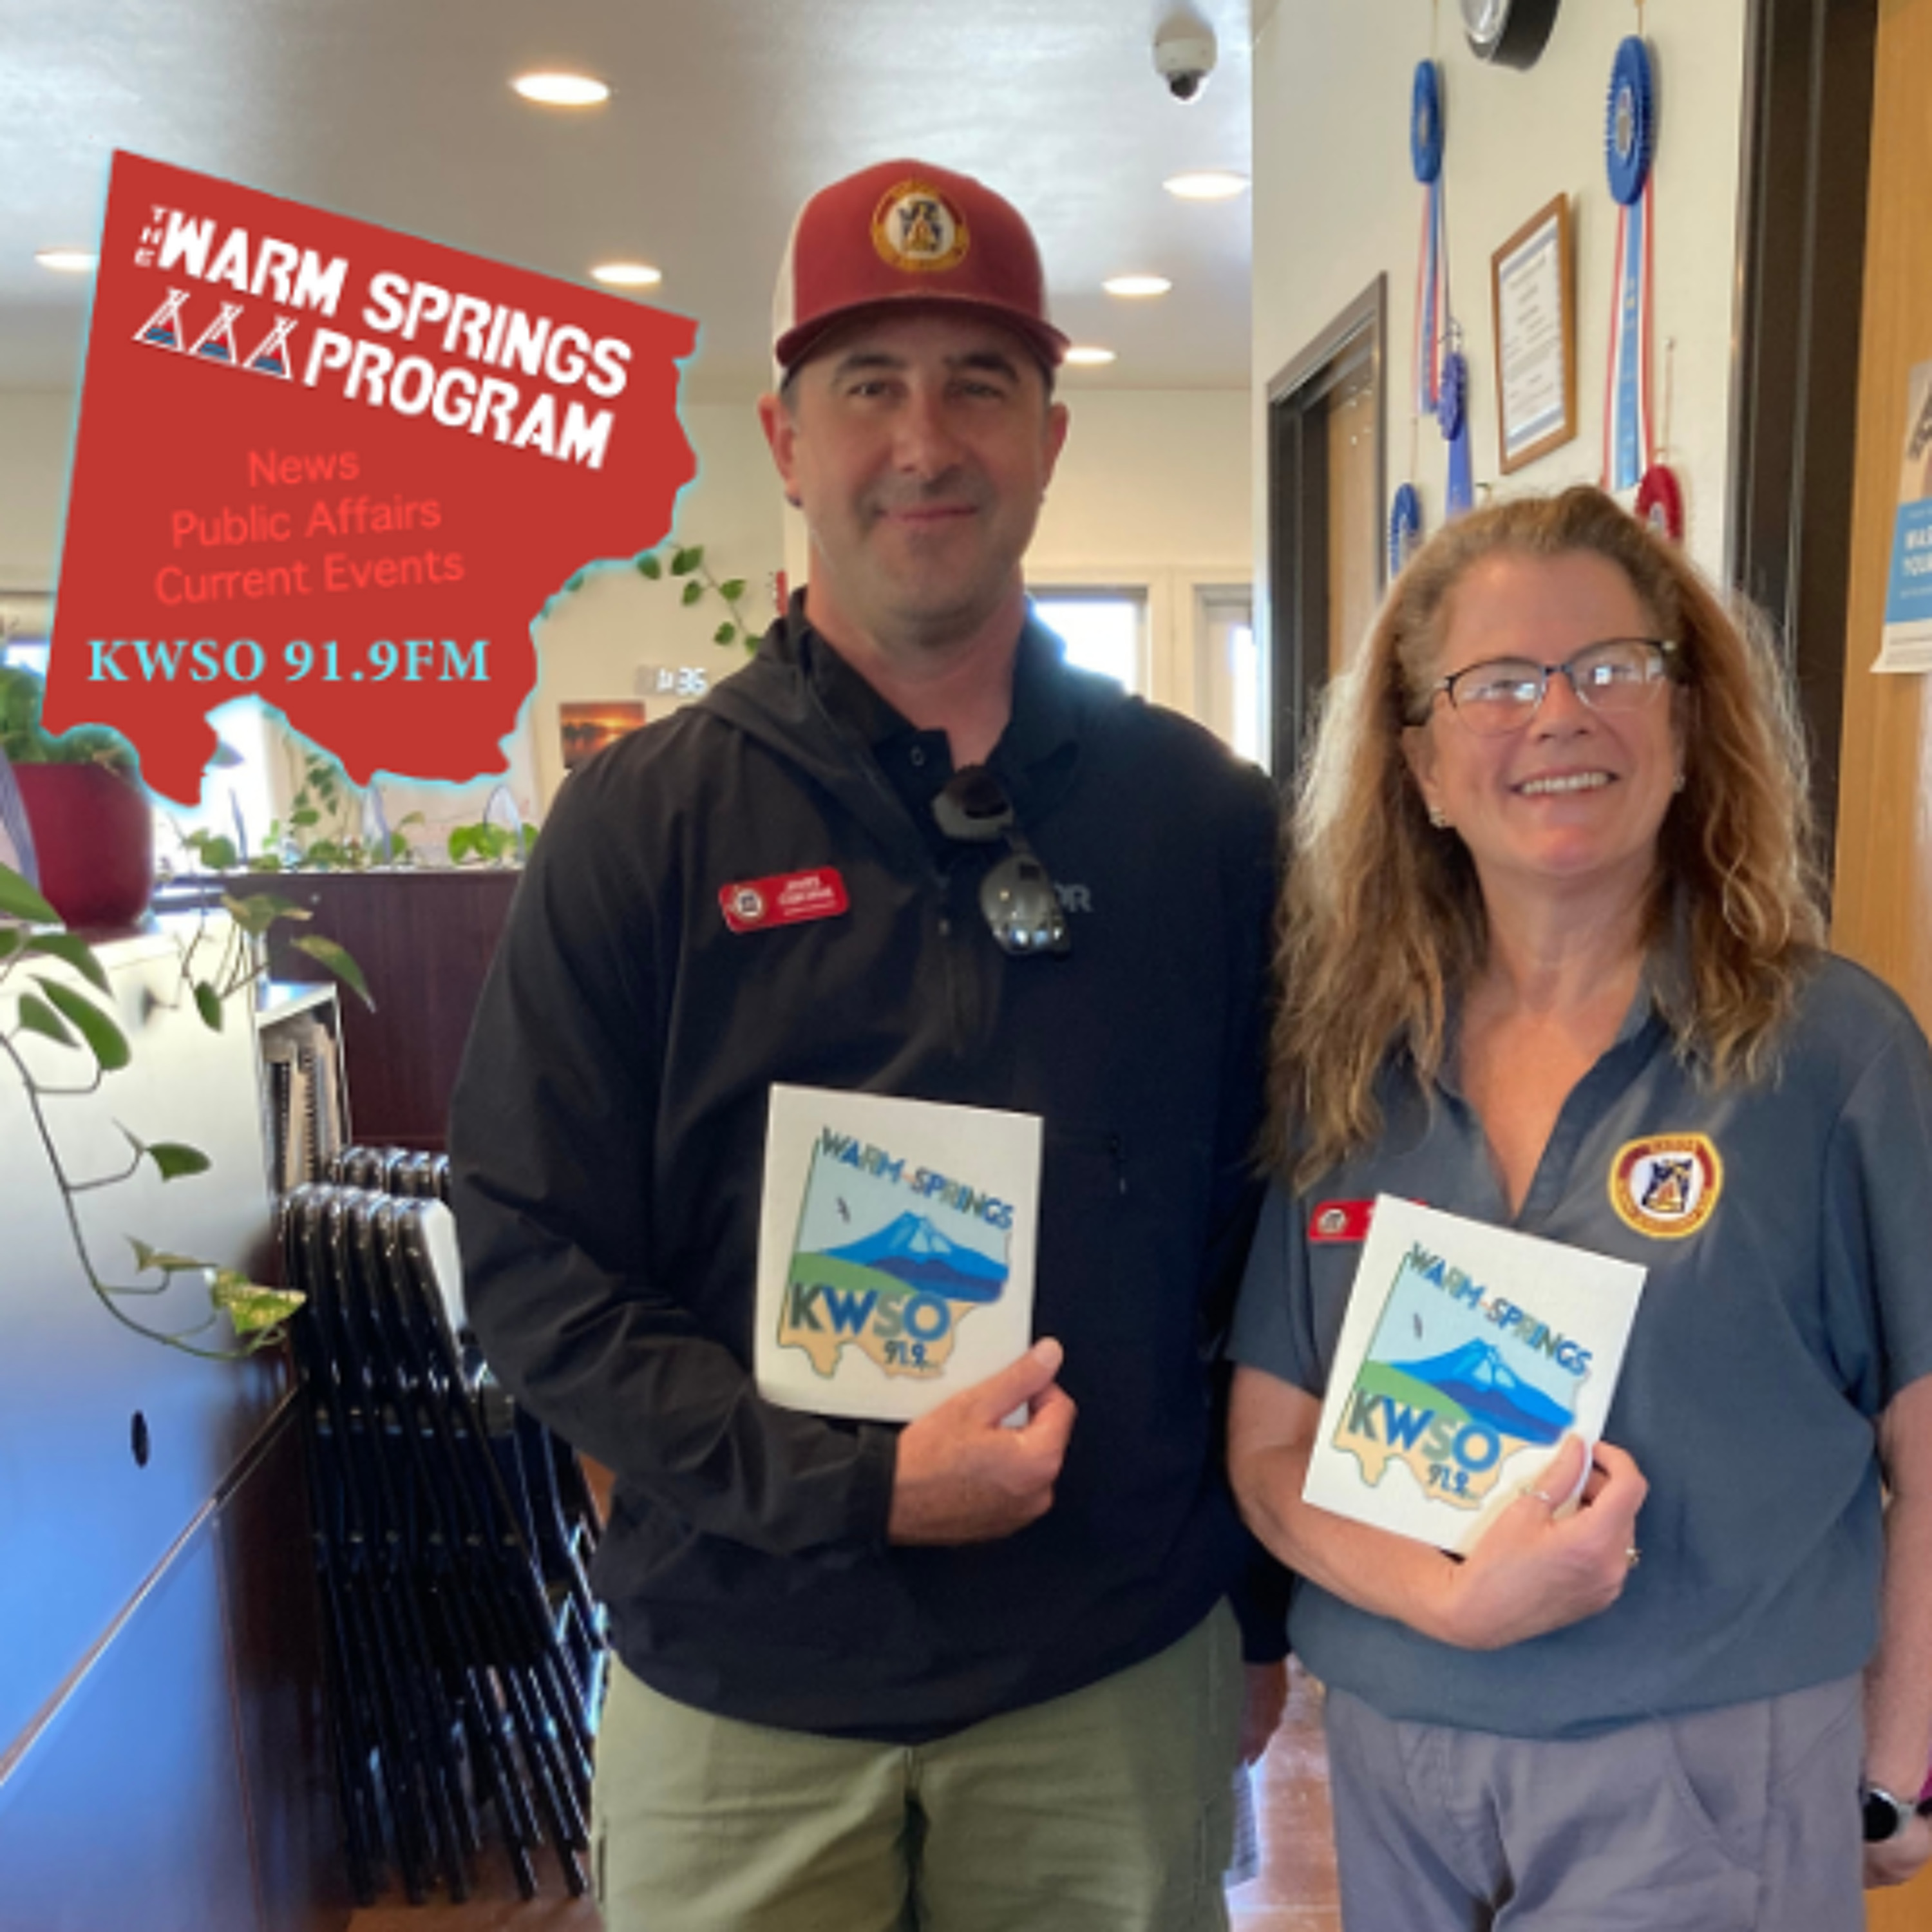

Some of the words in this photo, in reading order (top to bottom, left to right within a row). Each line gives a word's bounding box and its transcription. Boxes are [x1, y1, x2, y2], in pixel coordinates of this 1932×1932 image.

[820, 1126, 905, 1184] WARM
[909, 1167, 1014, 1230] SPRINGS
[790, 1283, 951, 1341] KWSO
[1408, 1242, 1486, 1310] WARM
[1485, 1297, 1593, 1377] SPRINGS
[1349, 1389, 1501, 1472] KWSO
